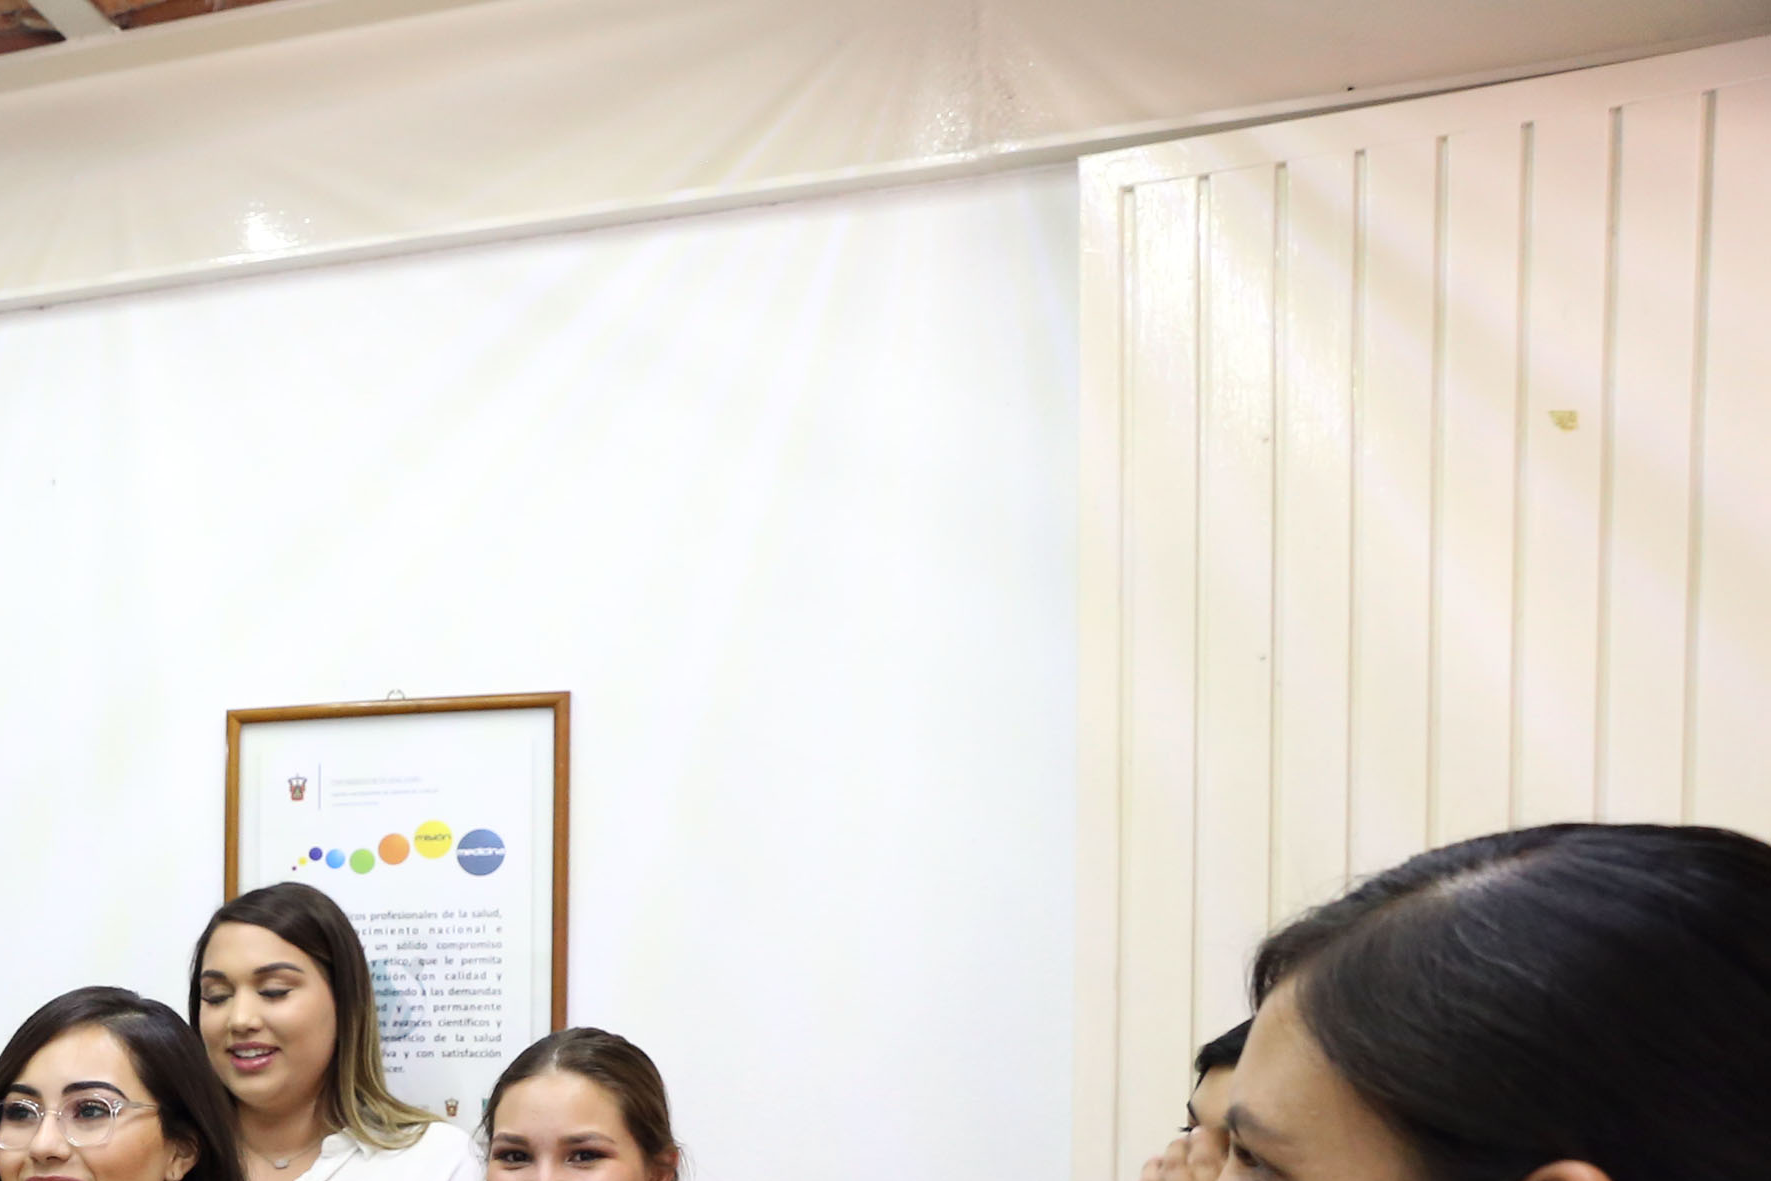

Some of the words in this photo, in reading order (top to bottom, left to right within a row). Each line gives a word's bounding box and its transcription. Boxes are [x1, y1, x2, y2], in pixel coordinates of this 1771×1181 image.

[370, 911, 437, 921] profesionales
[442, 911, 454, 919] de
[458, 910, 469, 918] la
[429, 925, 486, 935] nacional
[397, 941, 428, 950] sólido
[436, 941, 502, 950] compromiso
[445, 956, 454, 964] le
[461, 956, 502, 966] permita
[371, 971, 406, 981] fesión
[445, 971, 487, 980] calidad
[496, 974, 502, 982] y
[430, 987, 444, 996] las
[448, 988, 502, 996] demandas
[433, 1003, 502, 1013] permanente
[438, 1018, 490, 1027] científicos
[496, 1020, 502, 1028] y
[434, 1033, 446, 1042] de
[456, 1034, 465, 1042] la
[474, 1034, 502, 1042] salud
[416, 1050, 434, 1058] con
[442, 1048, 502, 1058] satisfacción
